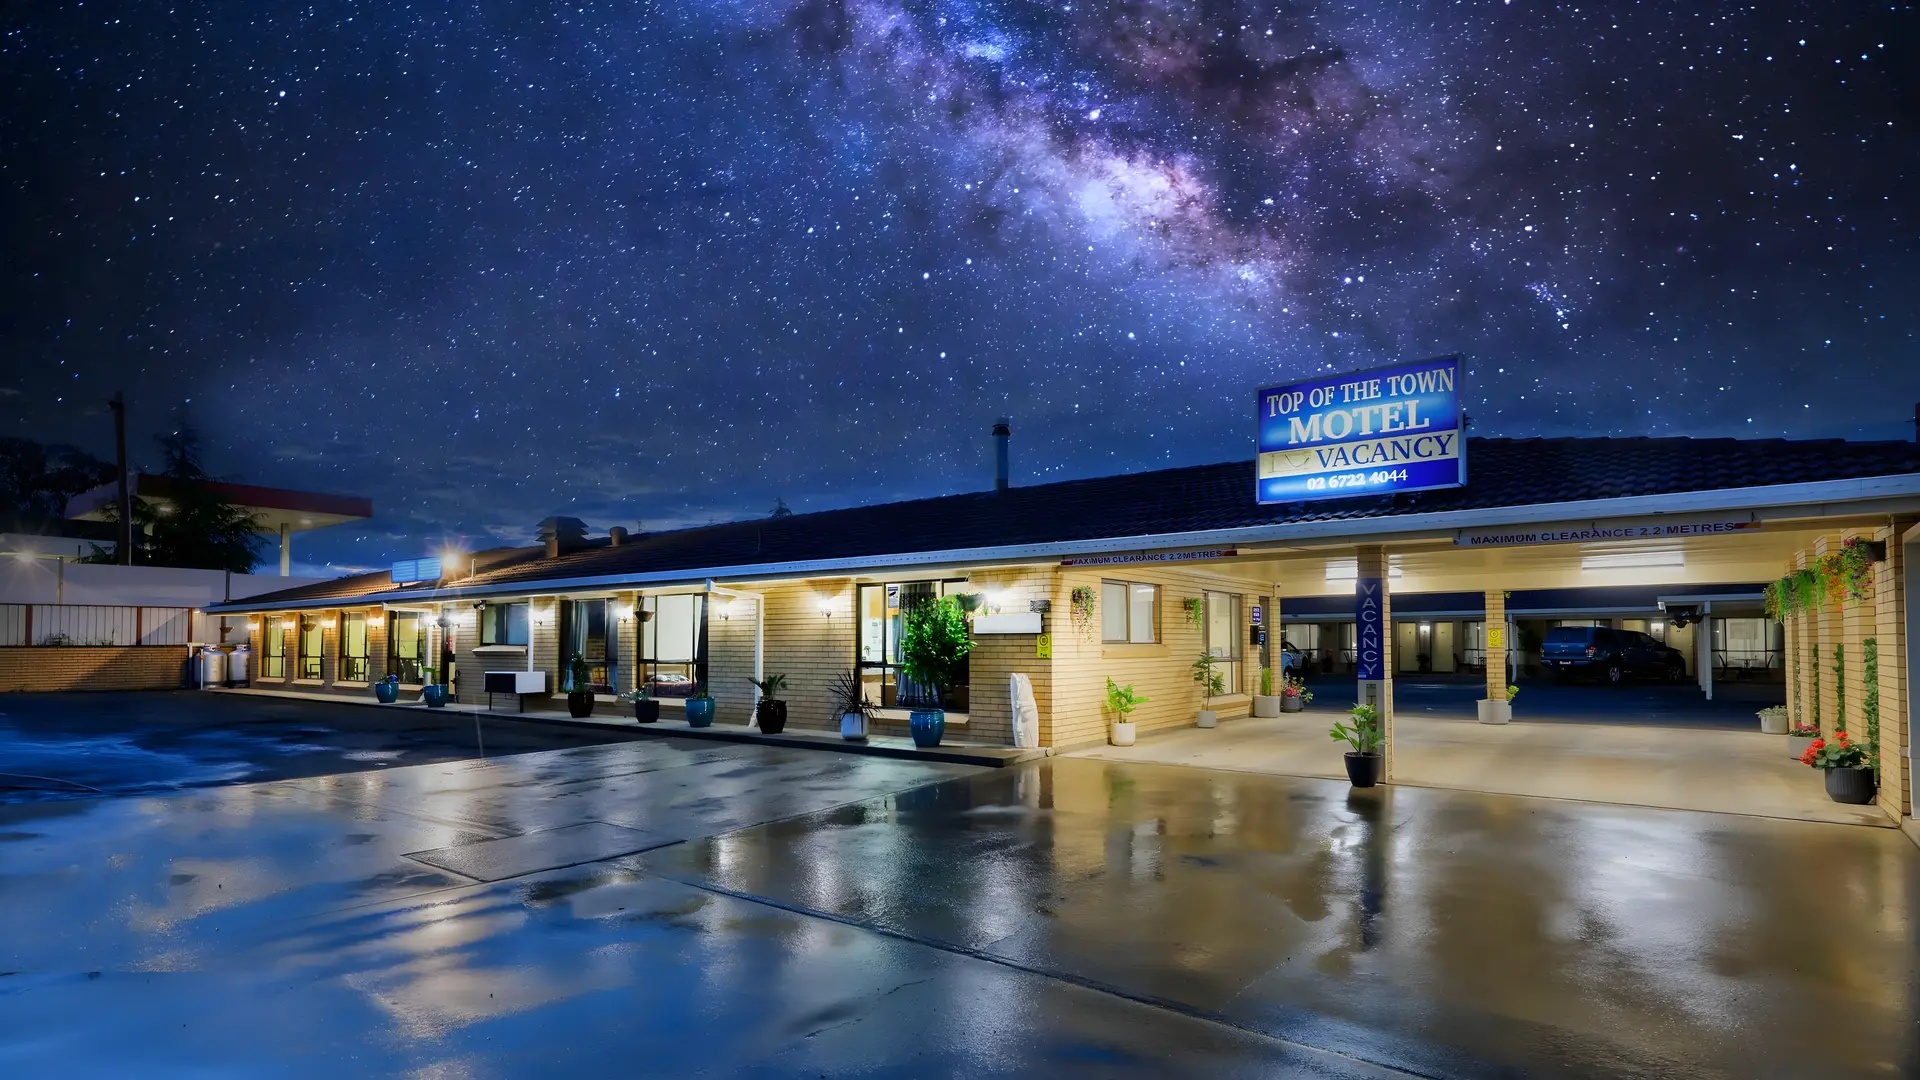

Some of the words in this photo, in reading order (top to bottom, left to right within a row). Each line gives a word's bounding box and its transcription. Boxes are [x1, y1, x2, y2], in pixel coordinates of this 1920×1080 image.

[1267, 392, 1304, 417] TOP
[1310, 387, 1335, 408] OF
[1341, 379, 1382, 402] THE
[1387, 368, 1454, 396] TOWN
[1288, 400, 1430, 444] MOTEL
[1316, 434, 1454, 468] VACANCY
[1307, 478, 1326, 490] 02
[1328, 474, 1366, 488] 6722
[1369, 470, 1408, 484] 4044
[1470, 533, 1537, 545] MAXIMUM
[1540, 528, 1633, 541] CLEARANCE
[1666, 522, 1735, 534] METRES
[1071, 556, 1111, 565] MAXIMUM
[1112, 553, 1166, 563] CLEARANCE
[1361, 583, 1377, 675] VACANCY
